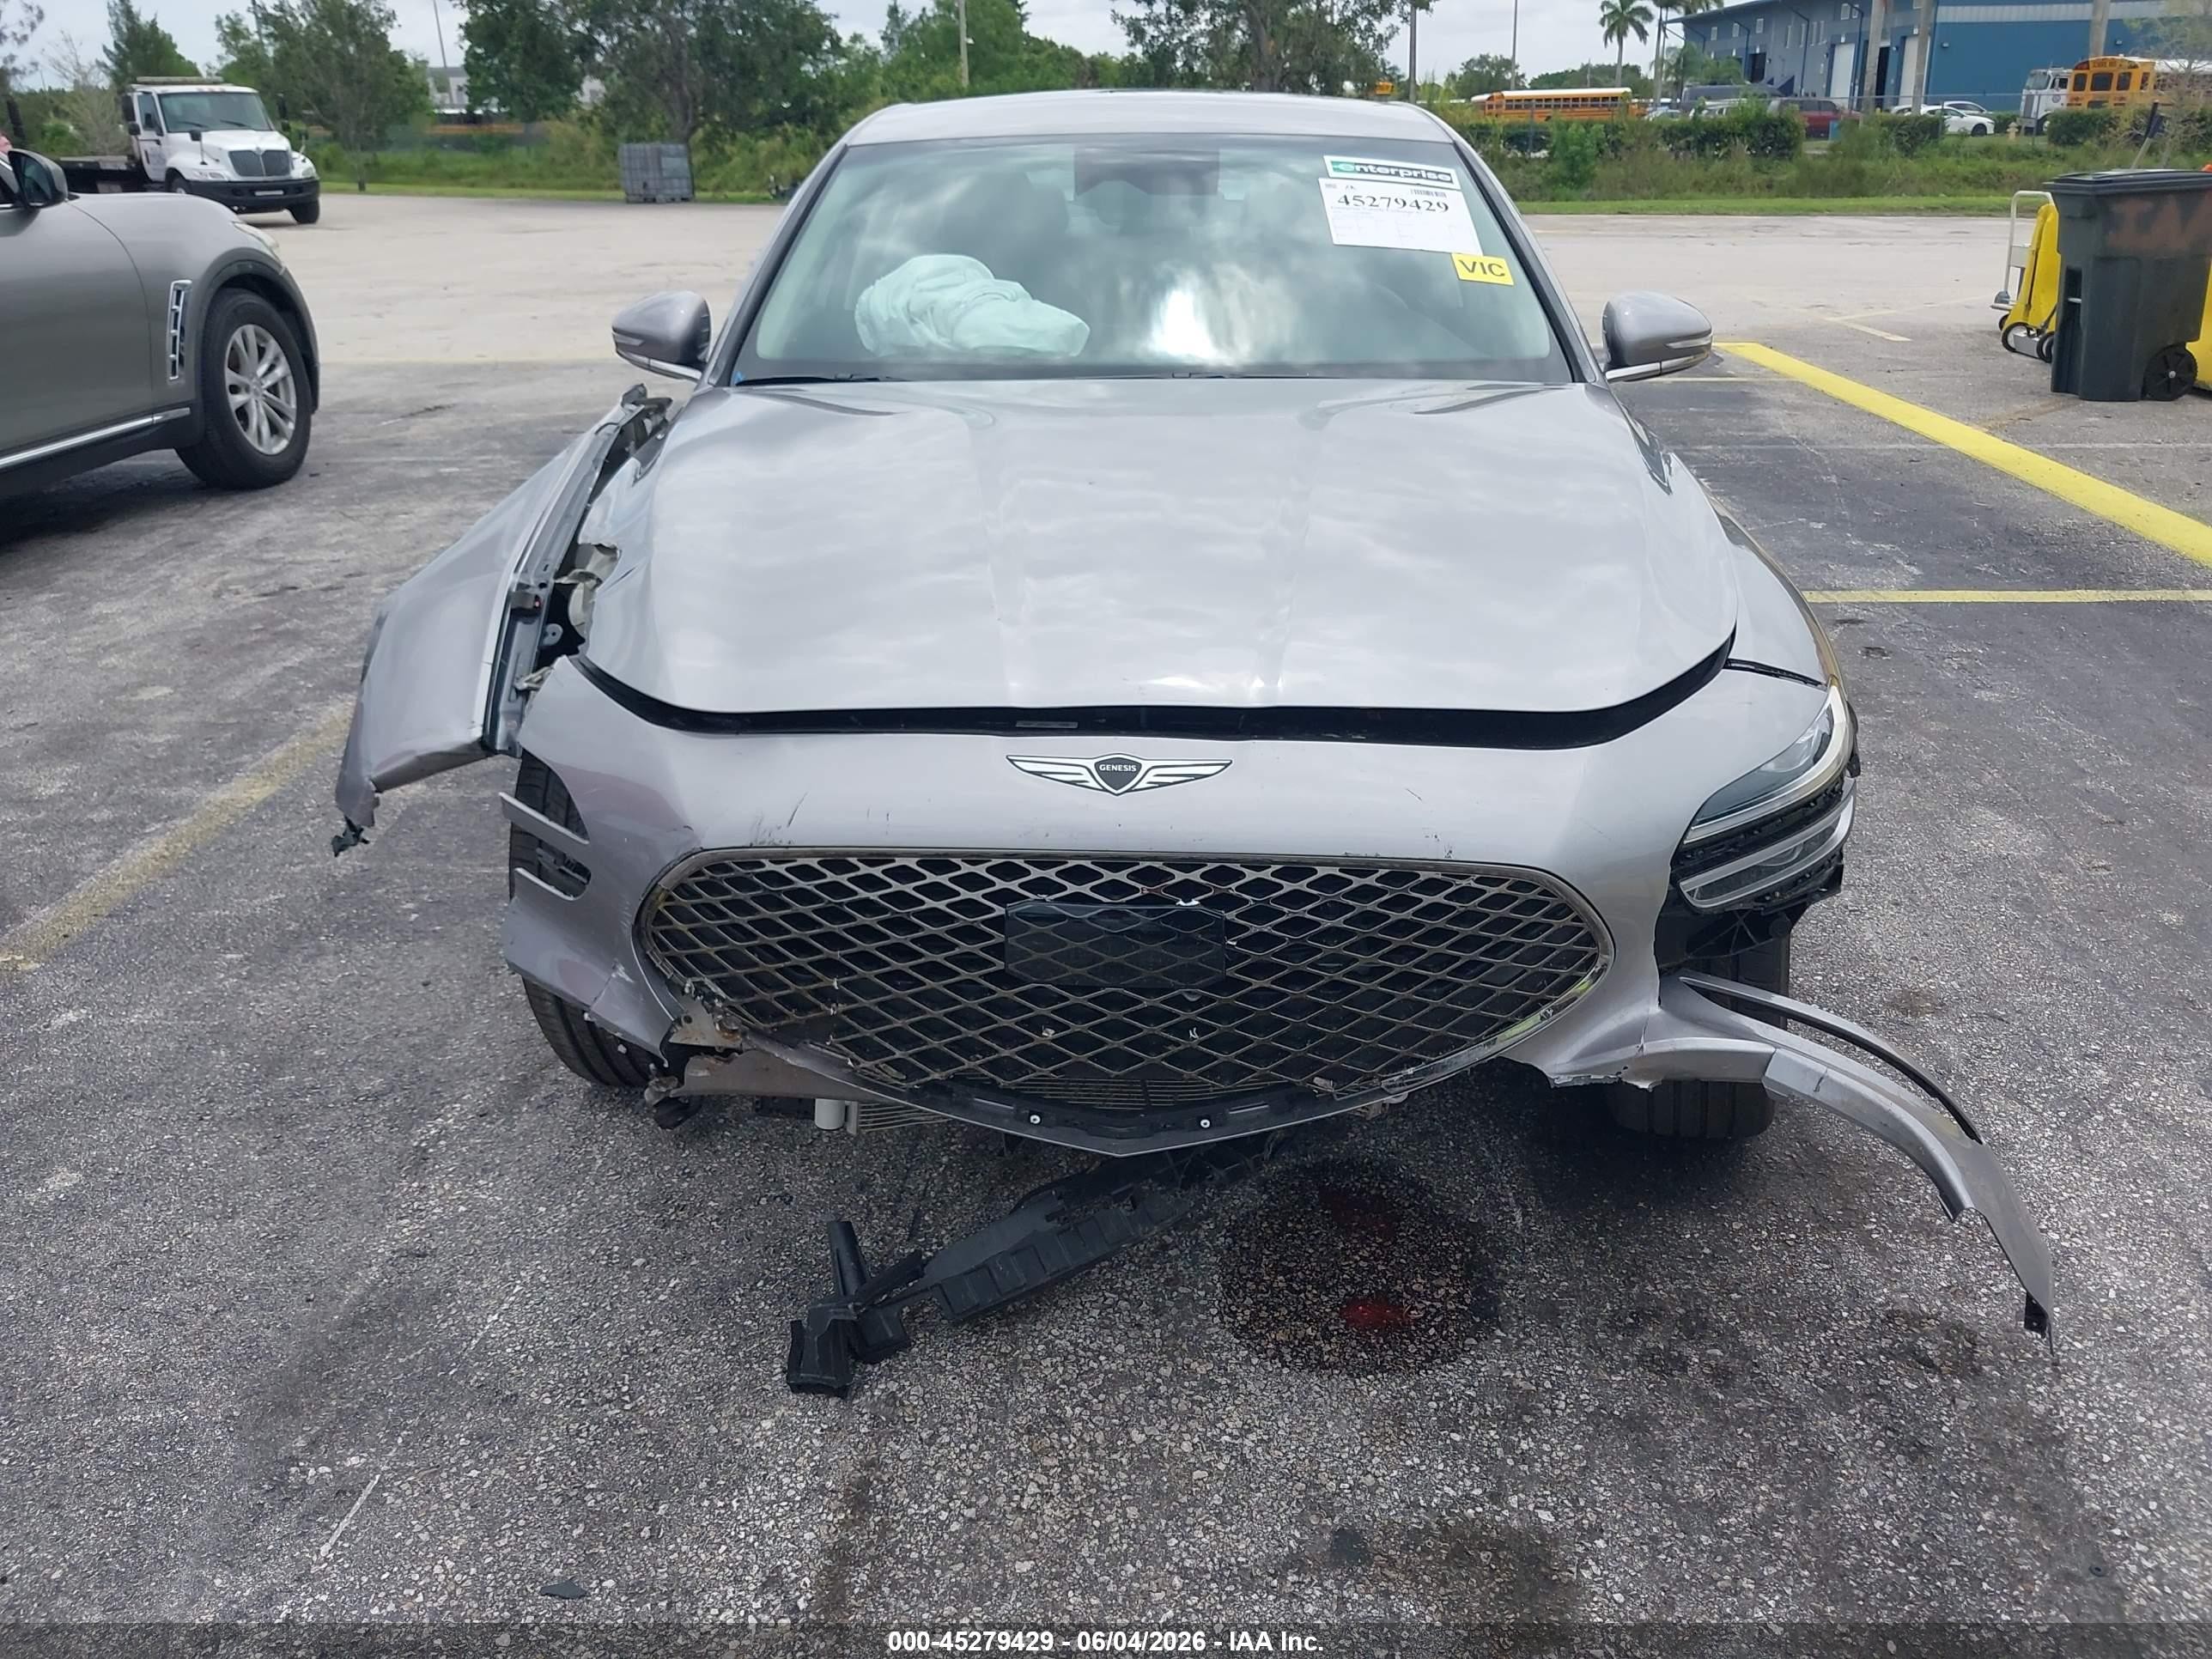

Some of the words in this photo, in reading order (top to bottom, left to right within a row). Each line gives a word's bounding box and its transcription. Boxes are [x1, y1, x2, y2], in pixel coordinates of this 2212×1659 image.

[1334, 163, 1451, 181] enterprise
[1338, 194, 1449, 213] 45279429
[1459, 259, 1505, 277] VIC
[1098, 763, 1137, 772] GENESIS
